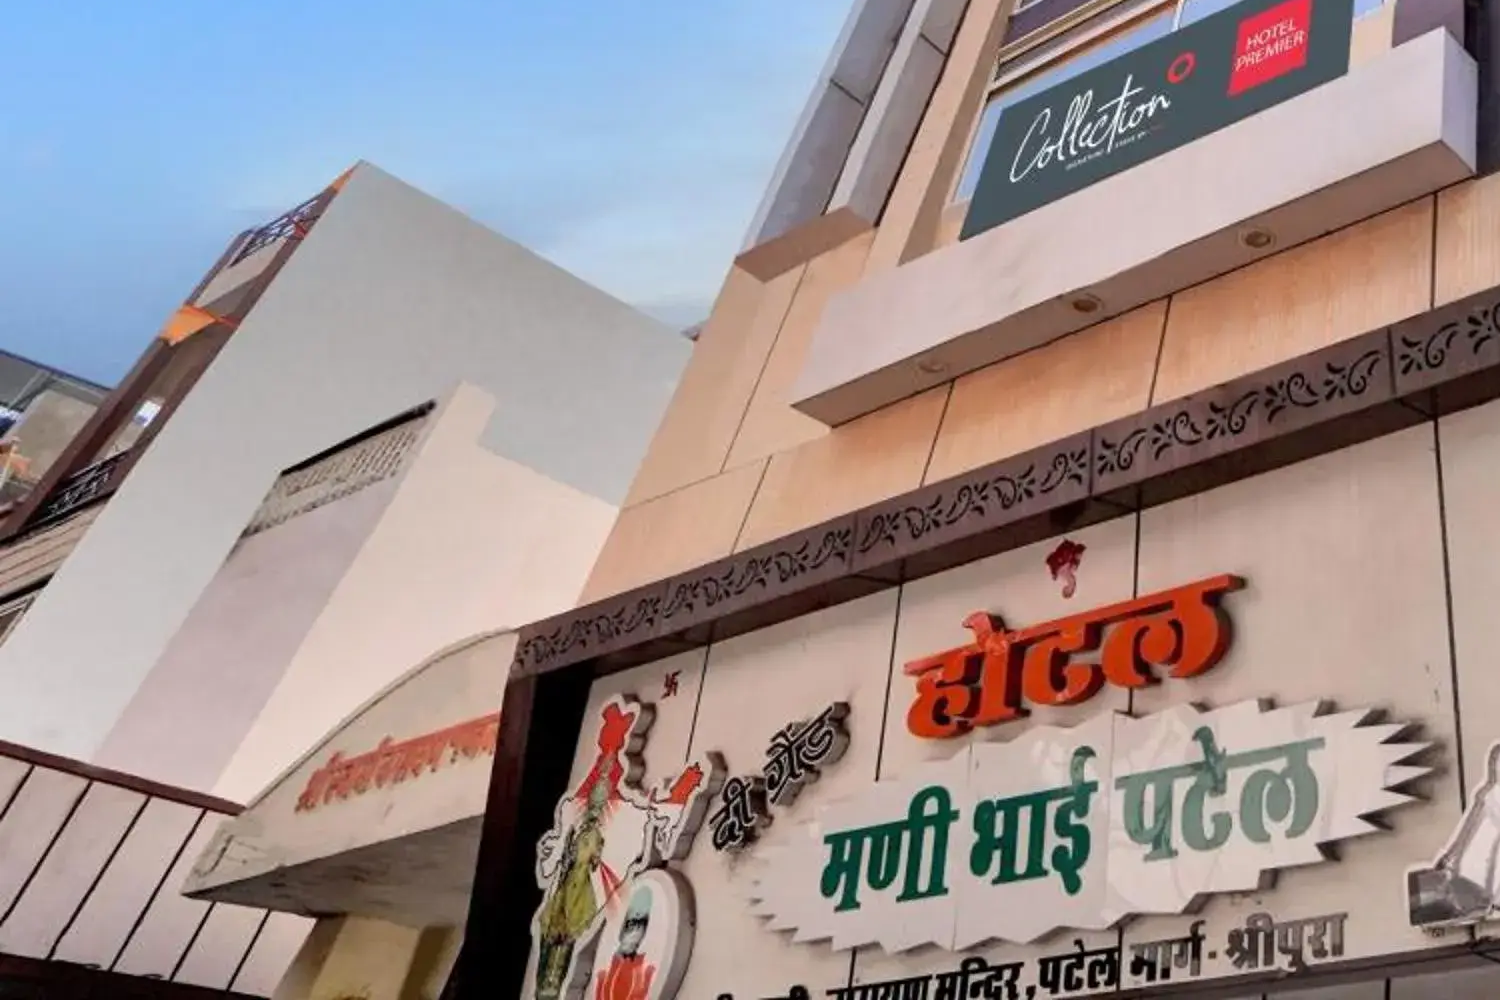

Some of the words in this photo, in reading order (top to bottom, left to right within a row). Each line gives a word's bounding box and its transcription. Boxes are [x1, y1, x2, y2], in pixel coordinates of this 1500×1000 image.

[1233, 29, 1307, 72] PREMIER
[1245, 18, 1296, 50] HOTEL
[1009, 73, 1171, 183] Collection
[904, 573, 1247, 738] होटल
[820, 785, 960, 913] मणी
[970, 745, 1099, 896] भाई
[1115, 726, 1325, 862] पटेल
[1038, 940, 1121, 992] पटेल
